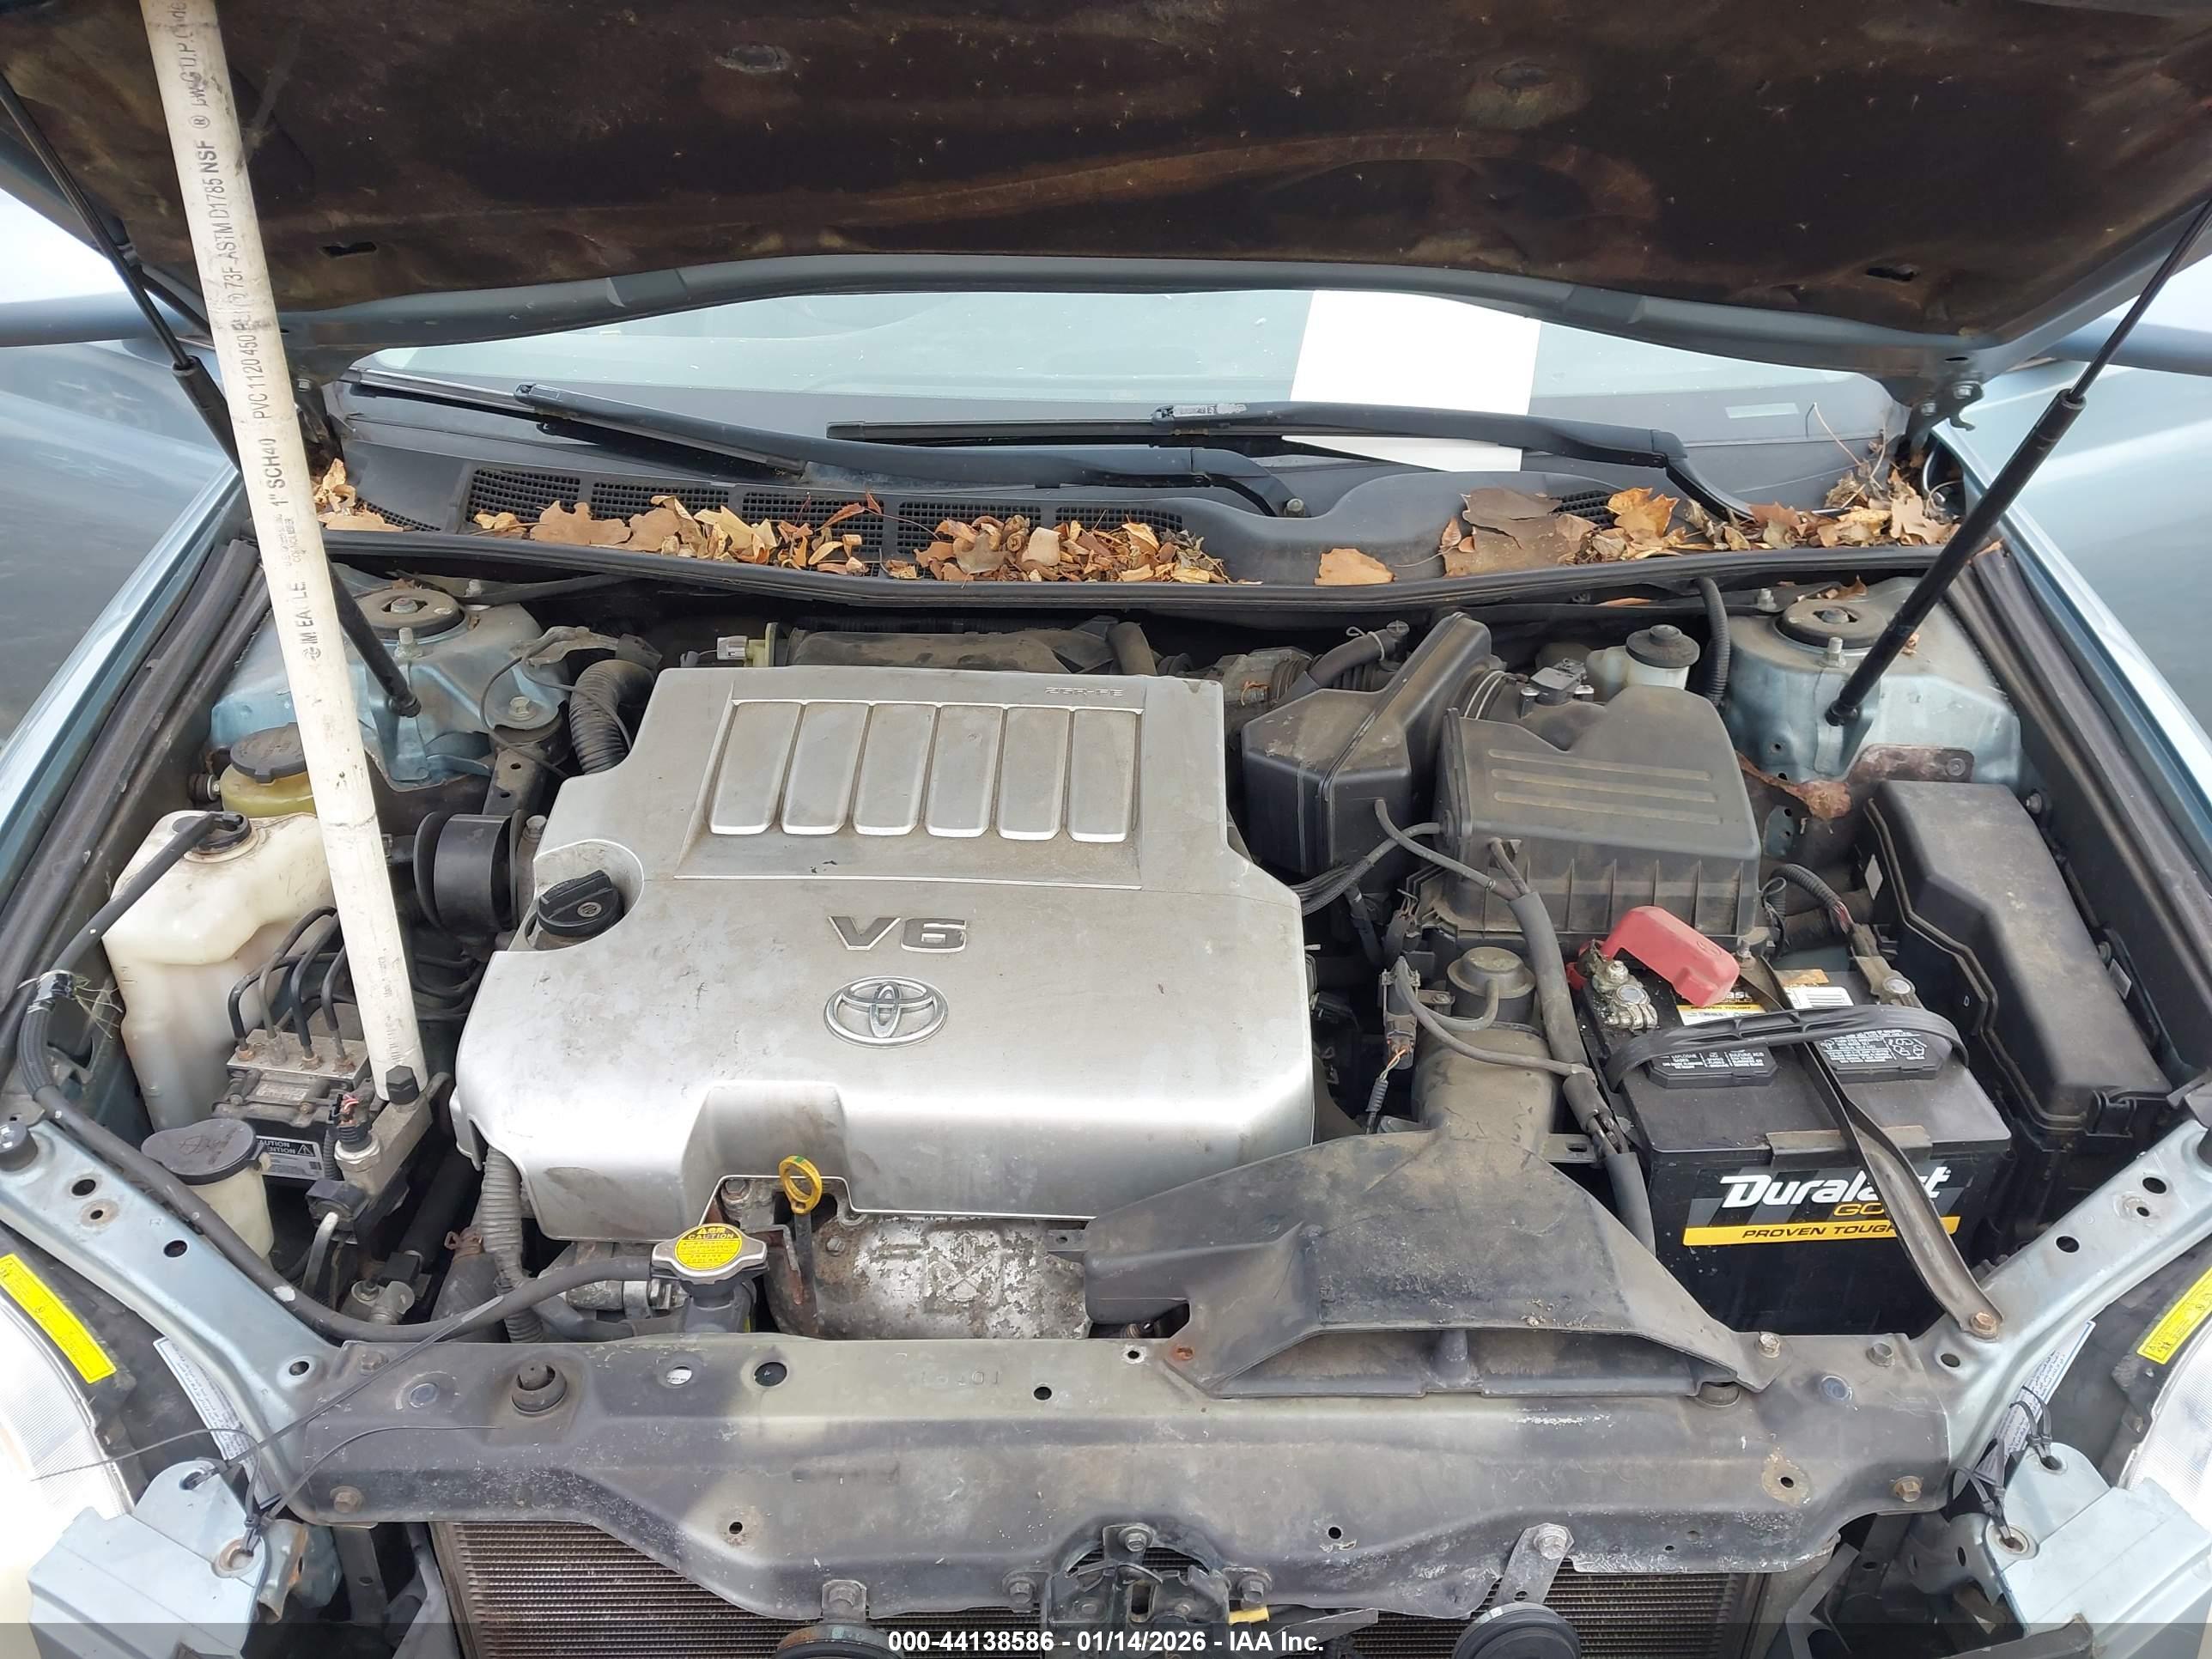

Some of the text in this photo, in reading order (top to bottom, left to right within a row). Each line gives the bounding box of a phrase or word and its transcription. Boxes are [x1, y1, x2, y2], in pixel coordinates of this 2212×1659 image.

[194, 140, 219, 173] NSF
[203, 179, 230, 219] D1785
[222, 266, 245, 289] 73F
[236, 334, 258, 355] 450
[240, 358, 265, 388] 1120
[248, 393, 271, 419] PVC
[258, 438, 286, 489] SCH40
[289, 581, 314, 628] EALE
[828, 915, 967, 953] V6
[1719, 1166, 1950, 1208] Duralat
[1833, 1202, 1885, 1217] GO
[1741, 1226, 1827, 1239] PROVEN
